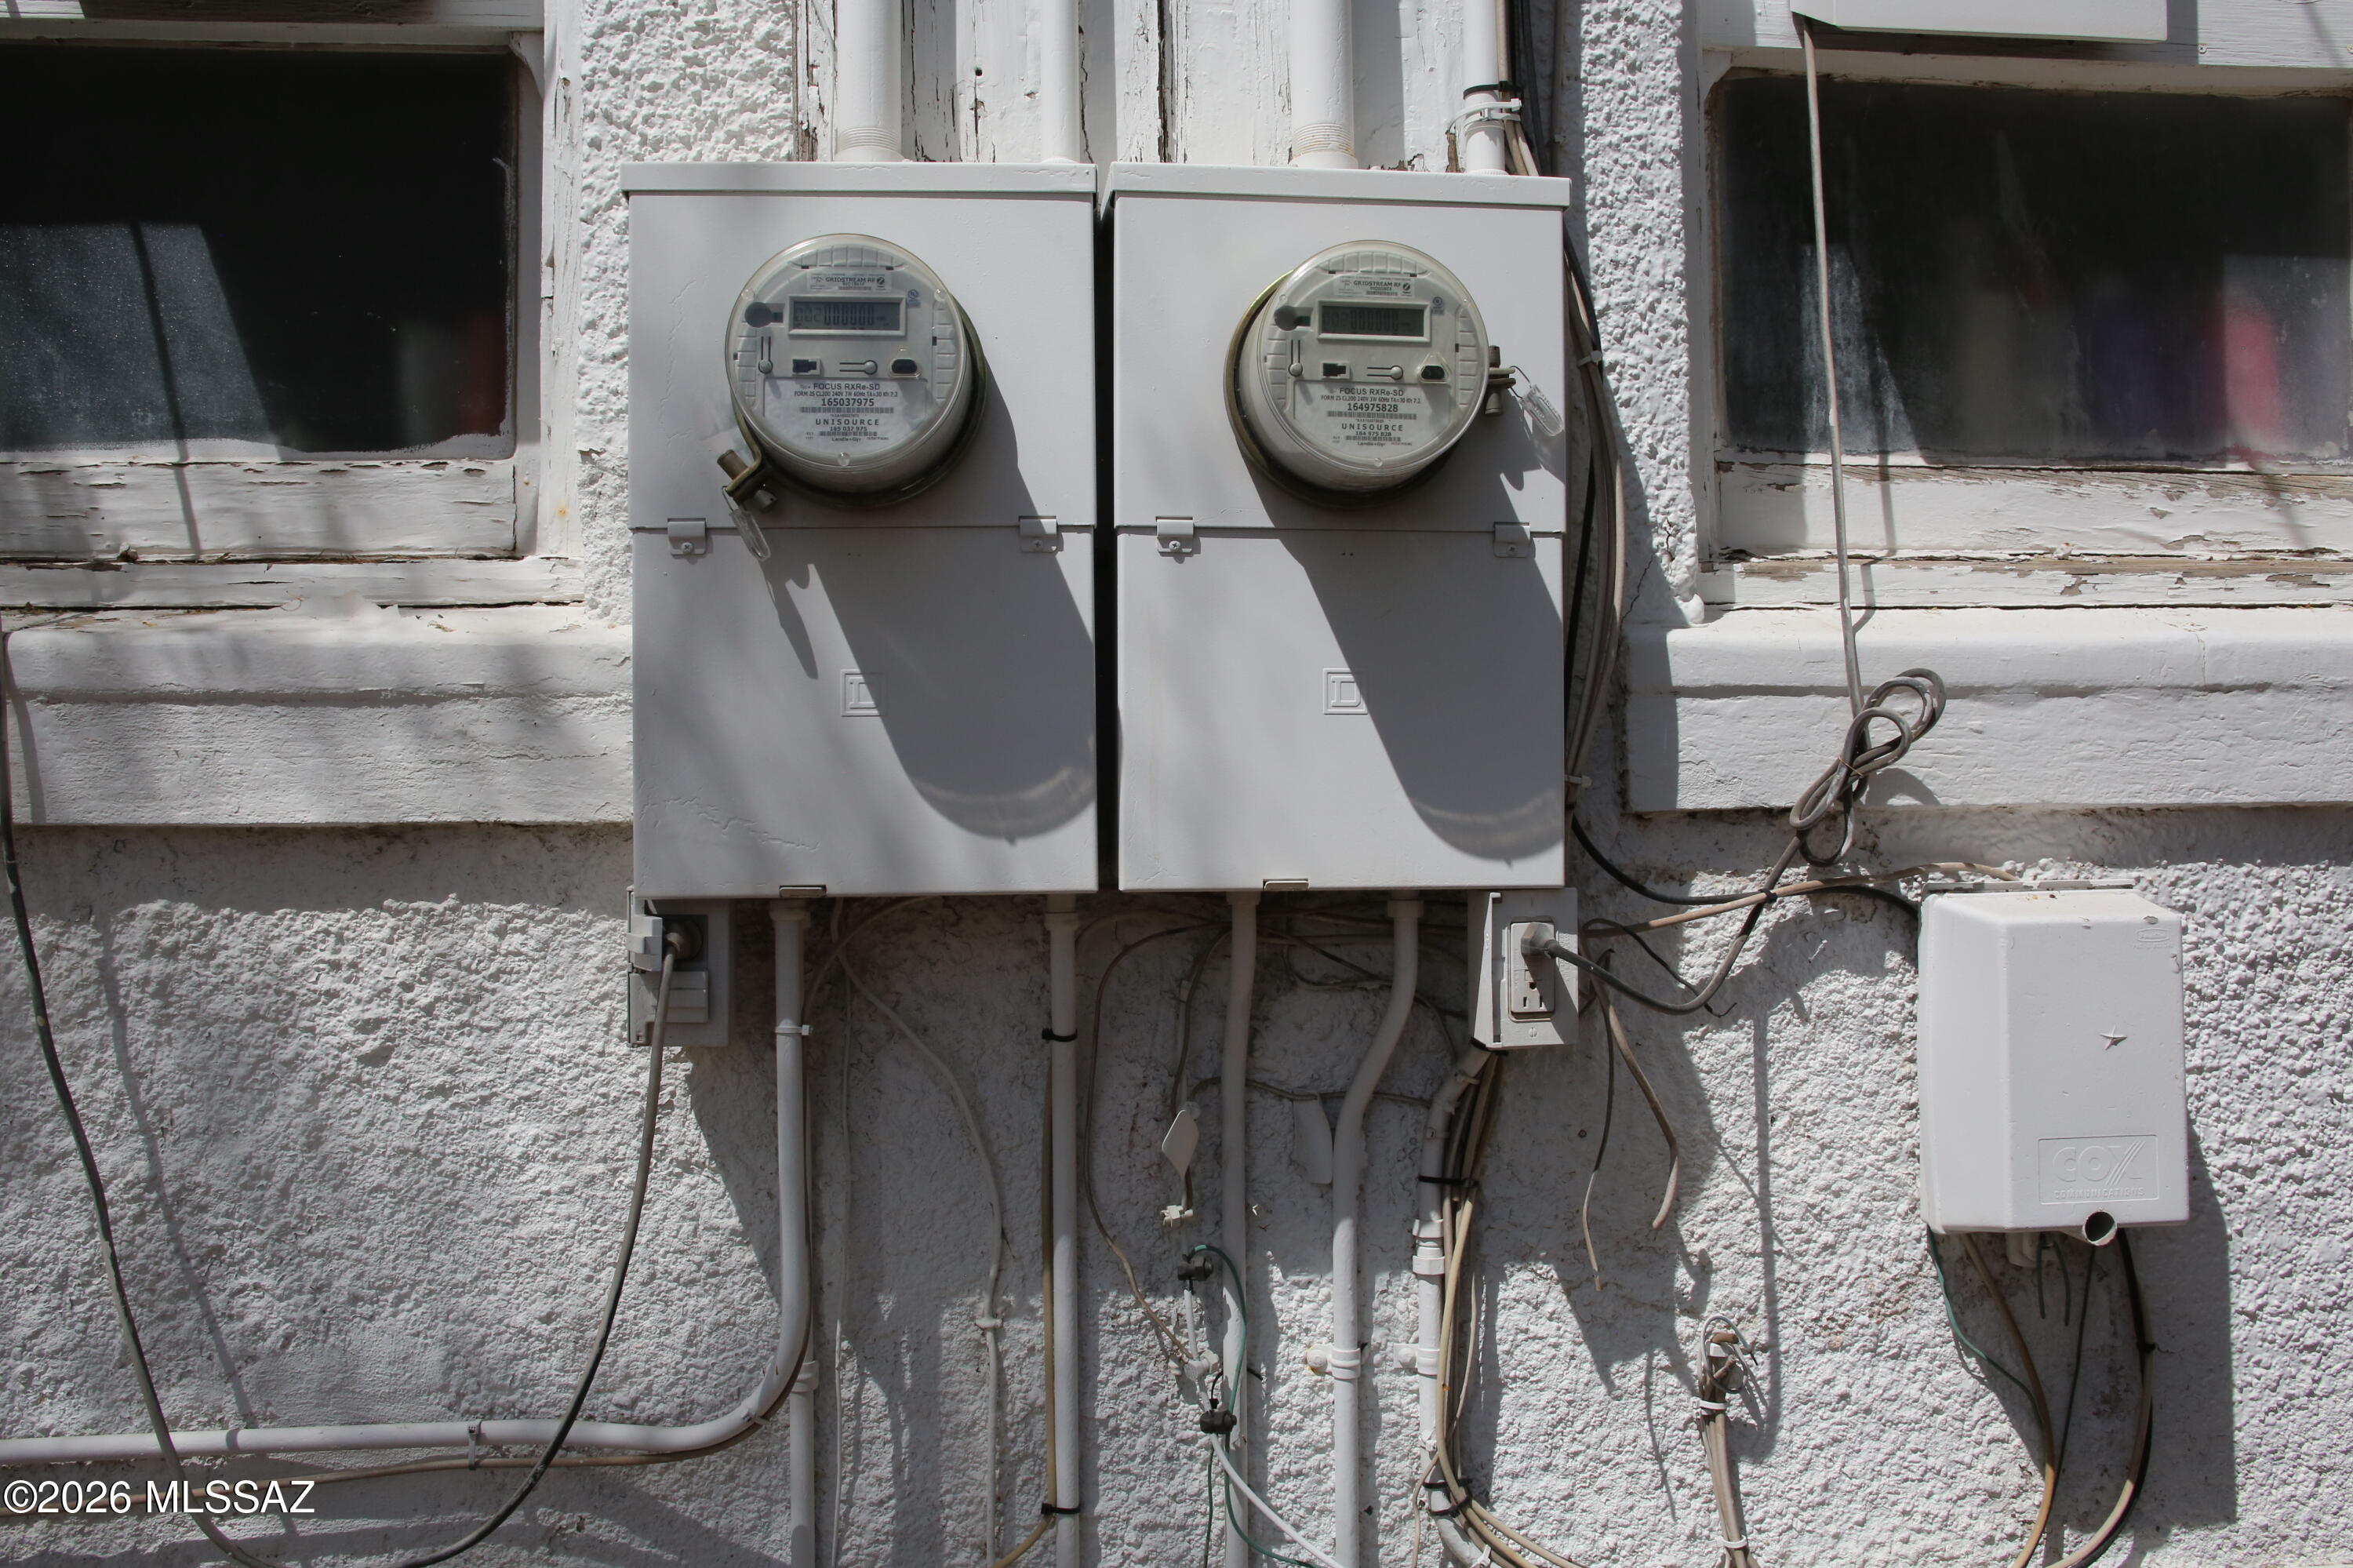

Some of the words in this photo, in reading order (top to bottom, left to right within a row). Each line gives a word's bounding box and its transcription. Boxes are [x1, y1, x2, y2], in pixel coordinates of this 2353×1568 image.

[1369, 388, 1404, 397] RXRe-SD
[821, 398, 875, 406] 165037975
[1347, 402, 1398, 413] 164975828
[1341, 423, 1404, 431] UNISOURCE
[2052, 1141, 2146, 1186] COX
[2053, 1186, 2146, 1200] COMMUNICATIONS
